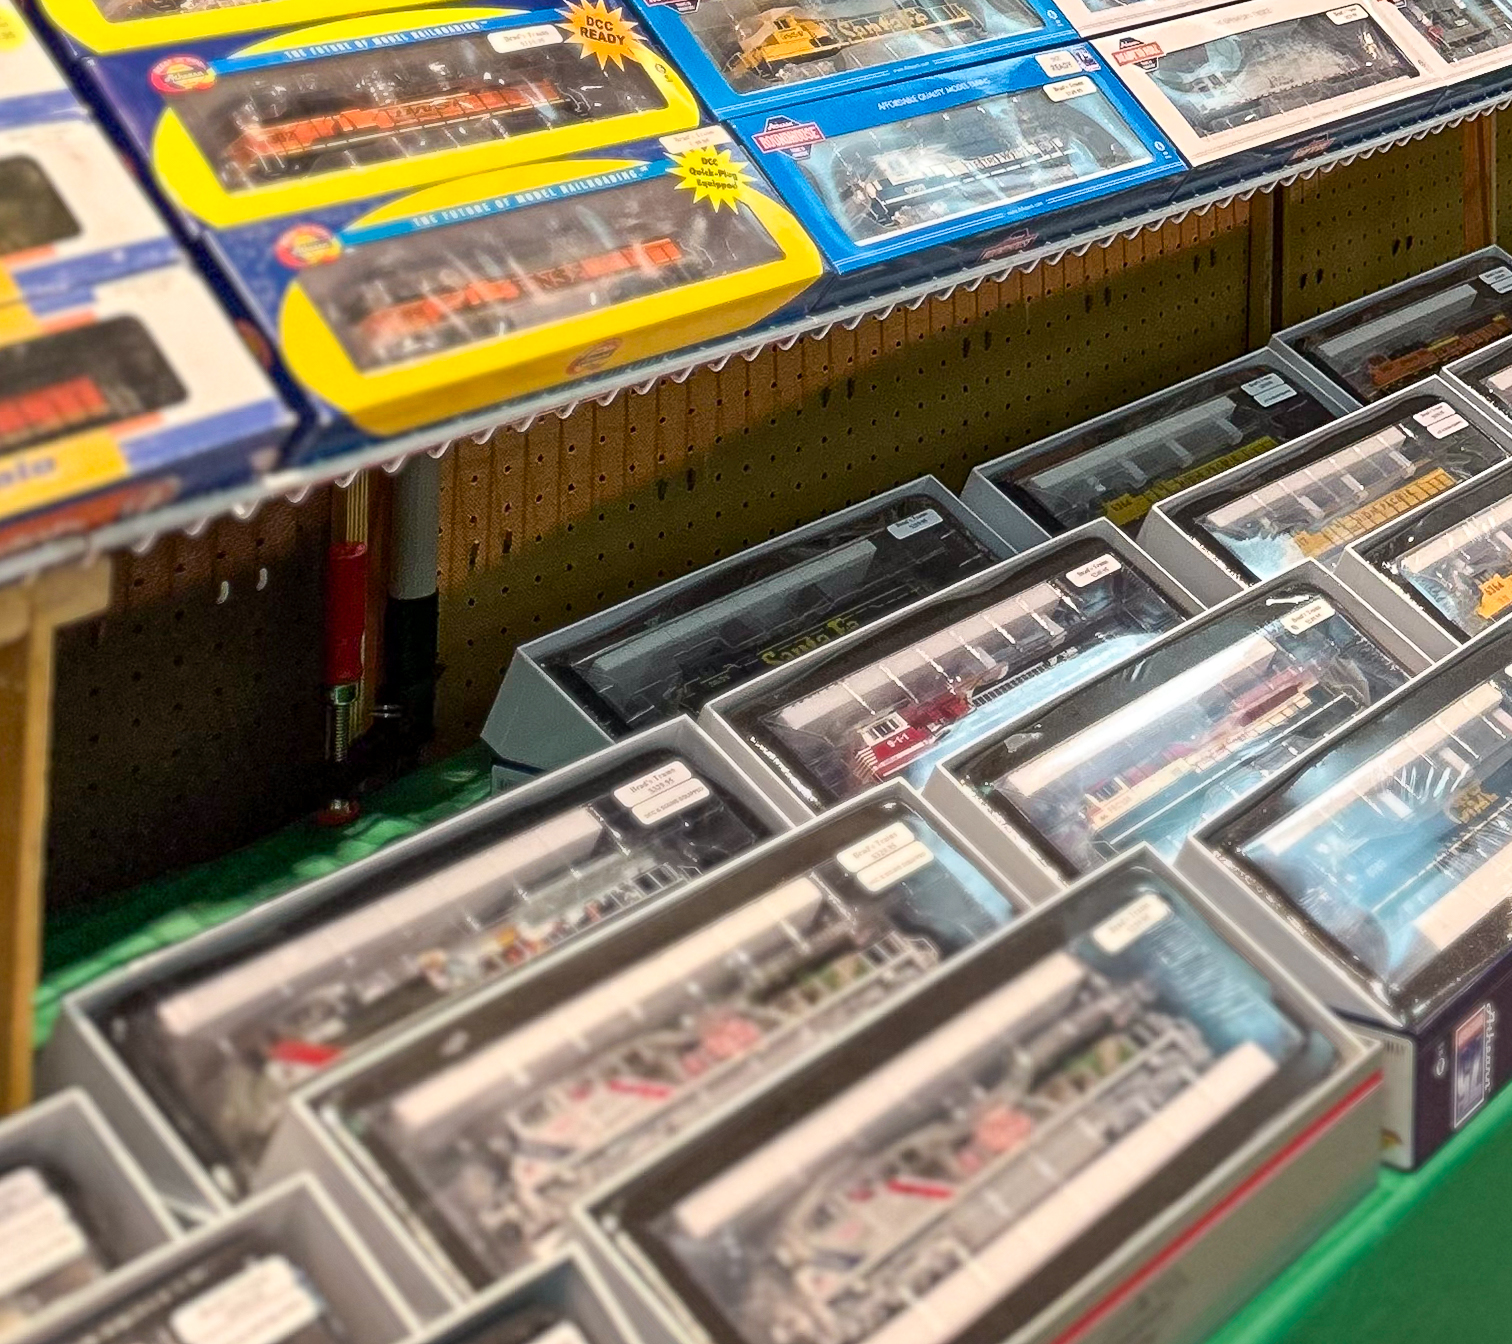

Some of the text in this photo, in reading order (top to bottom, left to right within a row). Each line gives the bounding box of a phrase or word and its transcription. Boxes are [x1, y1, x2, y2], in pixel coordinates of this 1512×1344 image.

[586, 15, 614, 32] DCC
[283, 34, 409, 60] THE FUTURE OF MODEL
[580, 26, 626, 46] READY
[1050, 62, 1073, 71] READY
[877, 82, 968, 111] AFFORDABLE QUALITY MODEL
[758, 127, 823, 150] ROUNDHOUSE
[689, 167, 738, 180] Quick-Plug
[700, 157, 718, 166] DCC
[697, 180, 739, 190] Equipped
[413, 186, 558, 228] THE FUTURE OF MODEL
[762, 616, 860, 667] Santa Fe
[630, 766, 676, 794] Brad's Trains
[852, 831, 897, 859] Brad's Trains
[1485, 1003, 1497, 1091] Athearn
